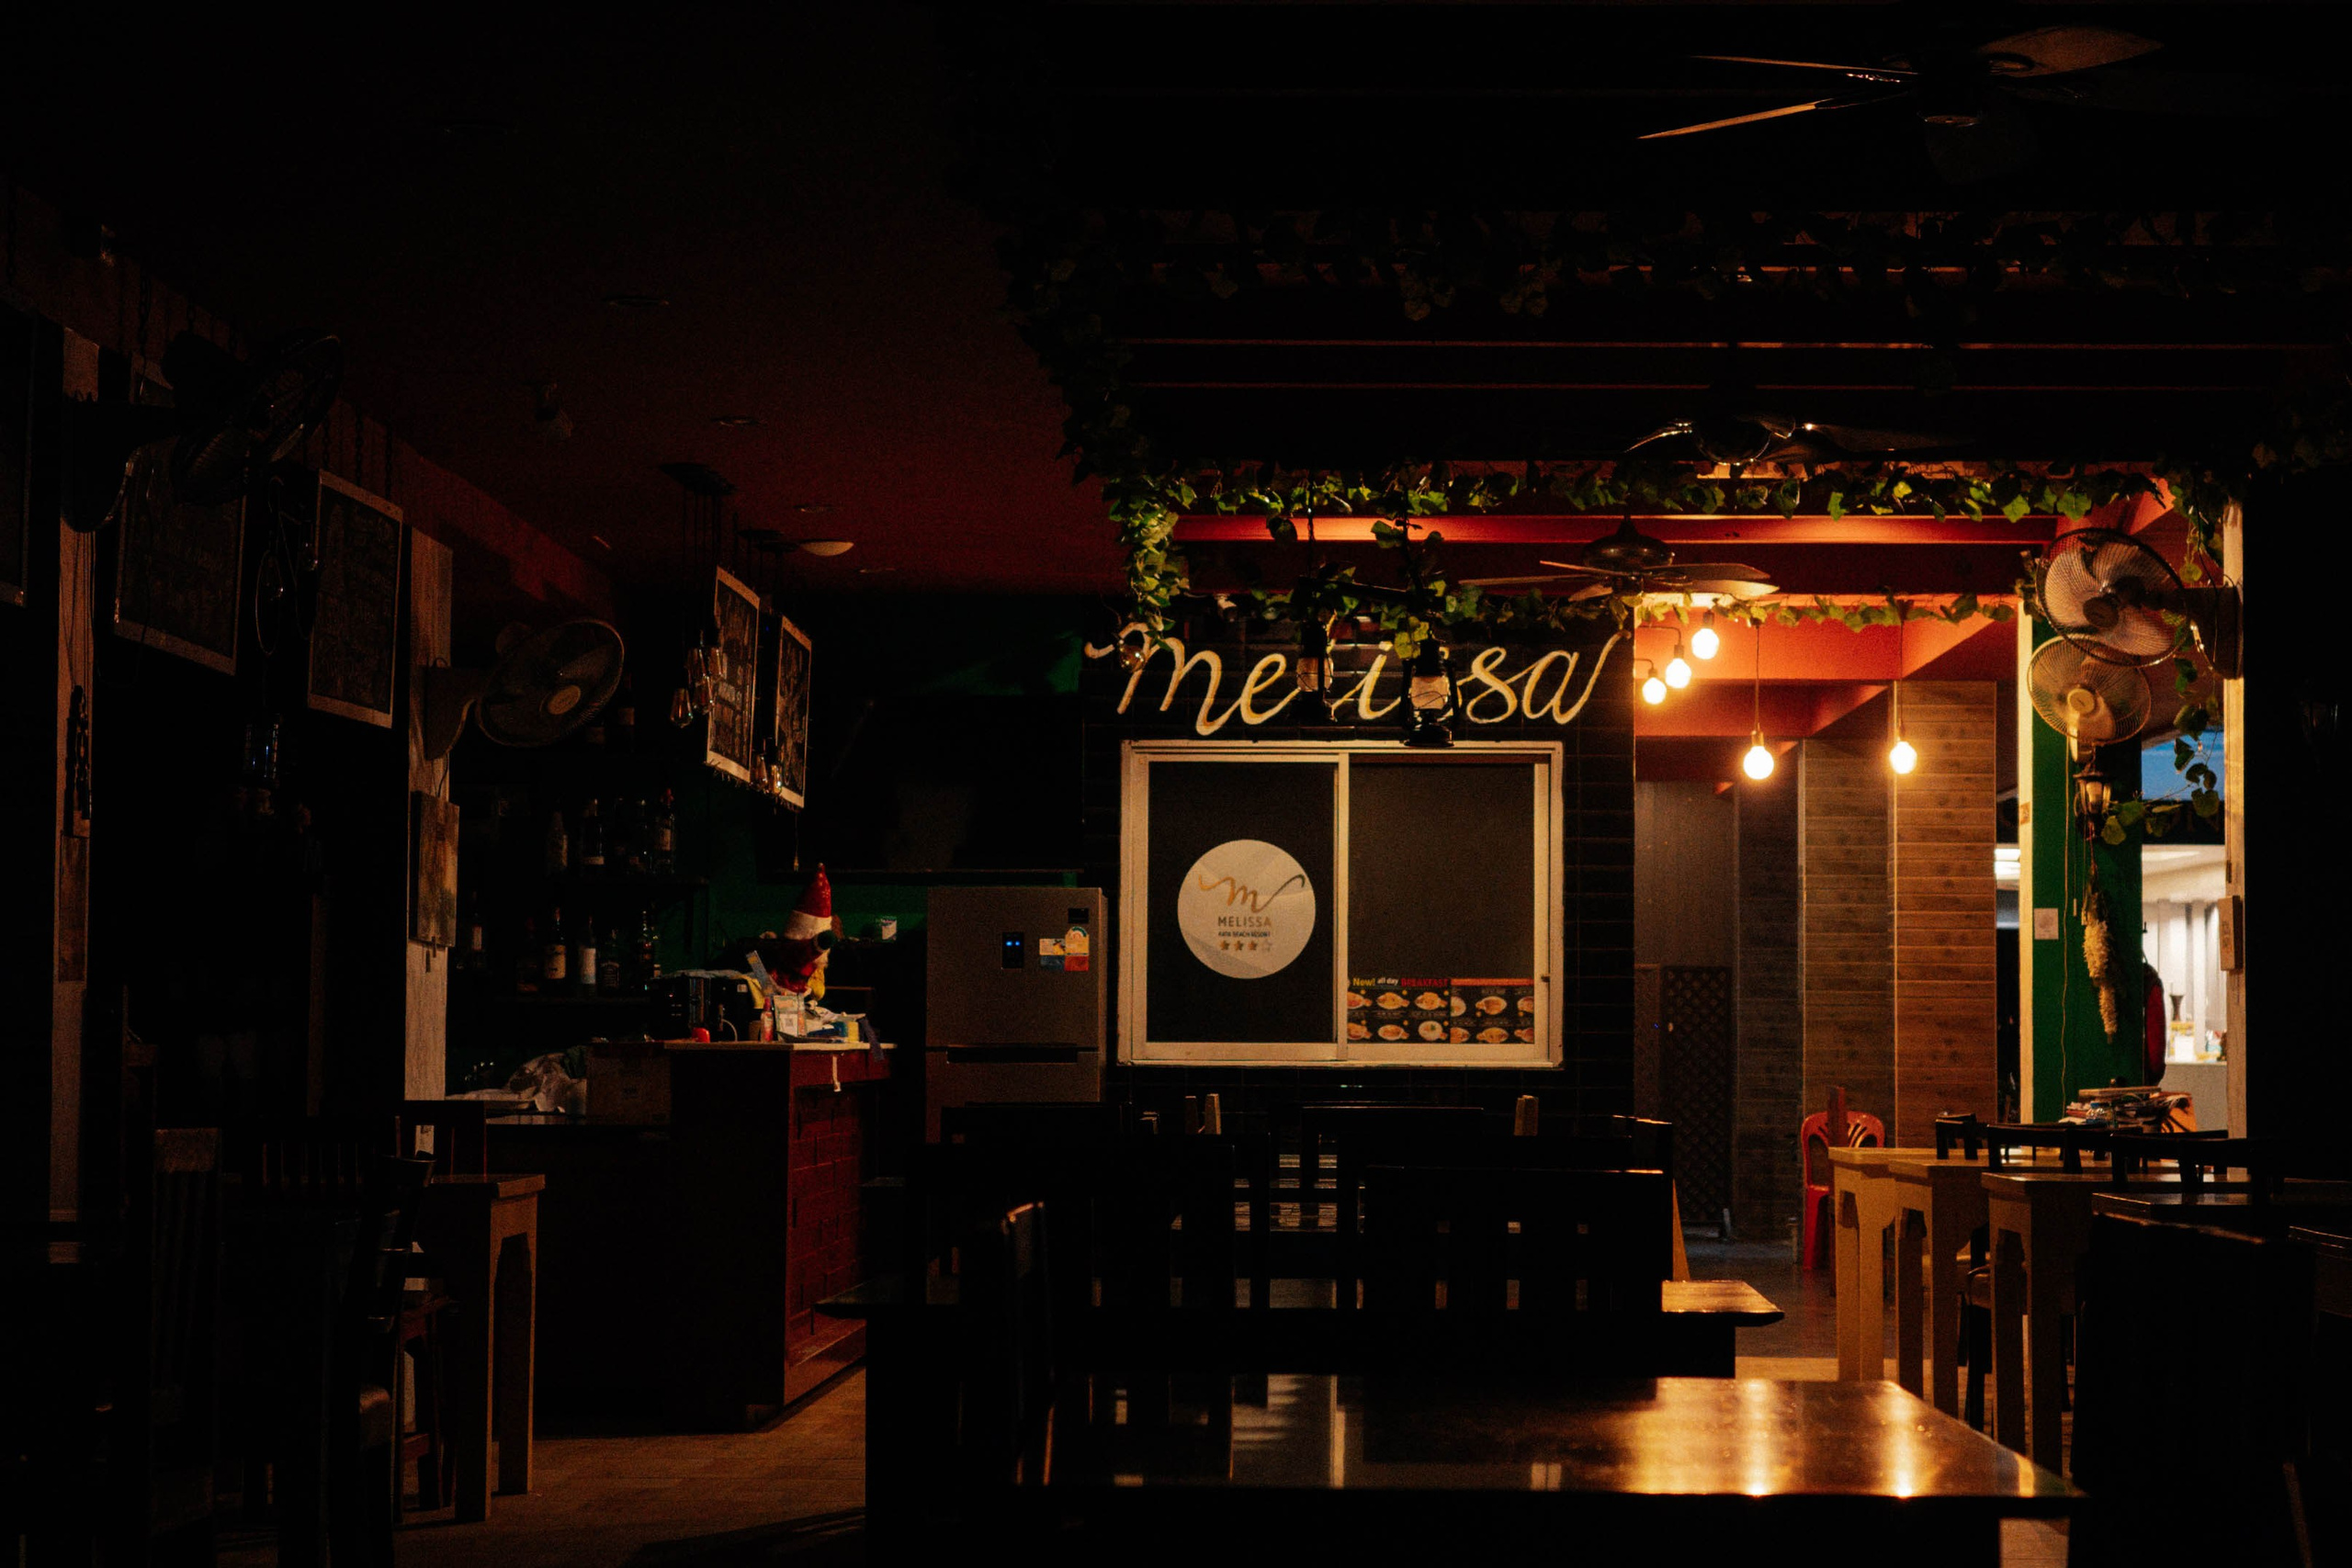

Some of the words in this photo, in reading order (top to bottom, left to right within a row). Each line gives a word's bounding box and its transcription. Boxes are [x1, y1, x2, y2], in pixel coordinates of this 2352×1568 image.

[1085, 621, 1632, 736] meisa
[1218, 916, 1272, 927] MELISSA
[1386, 976, 1398, 986] day
[1401, 977, 1449, 987] BREAKFAST
